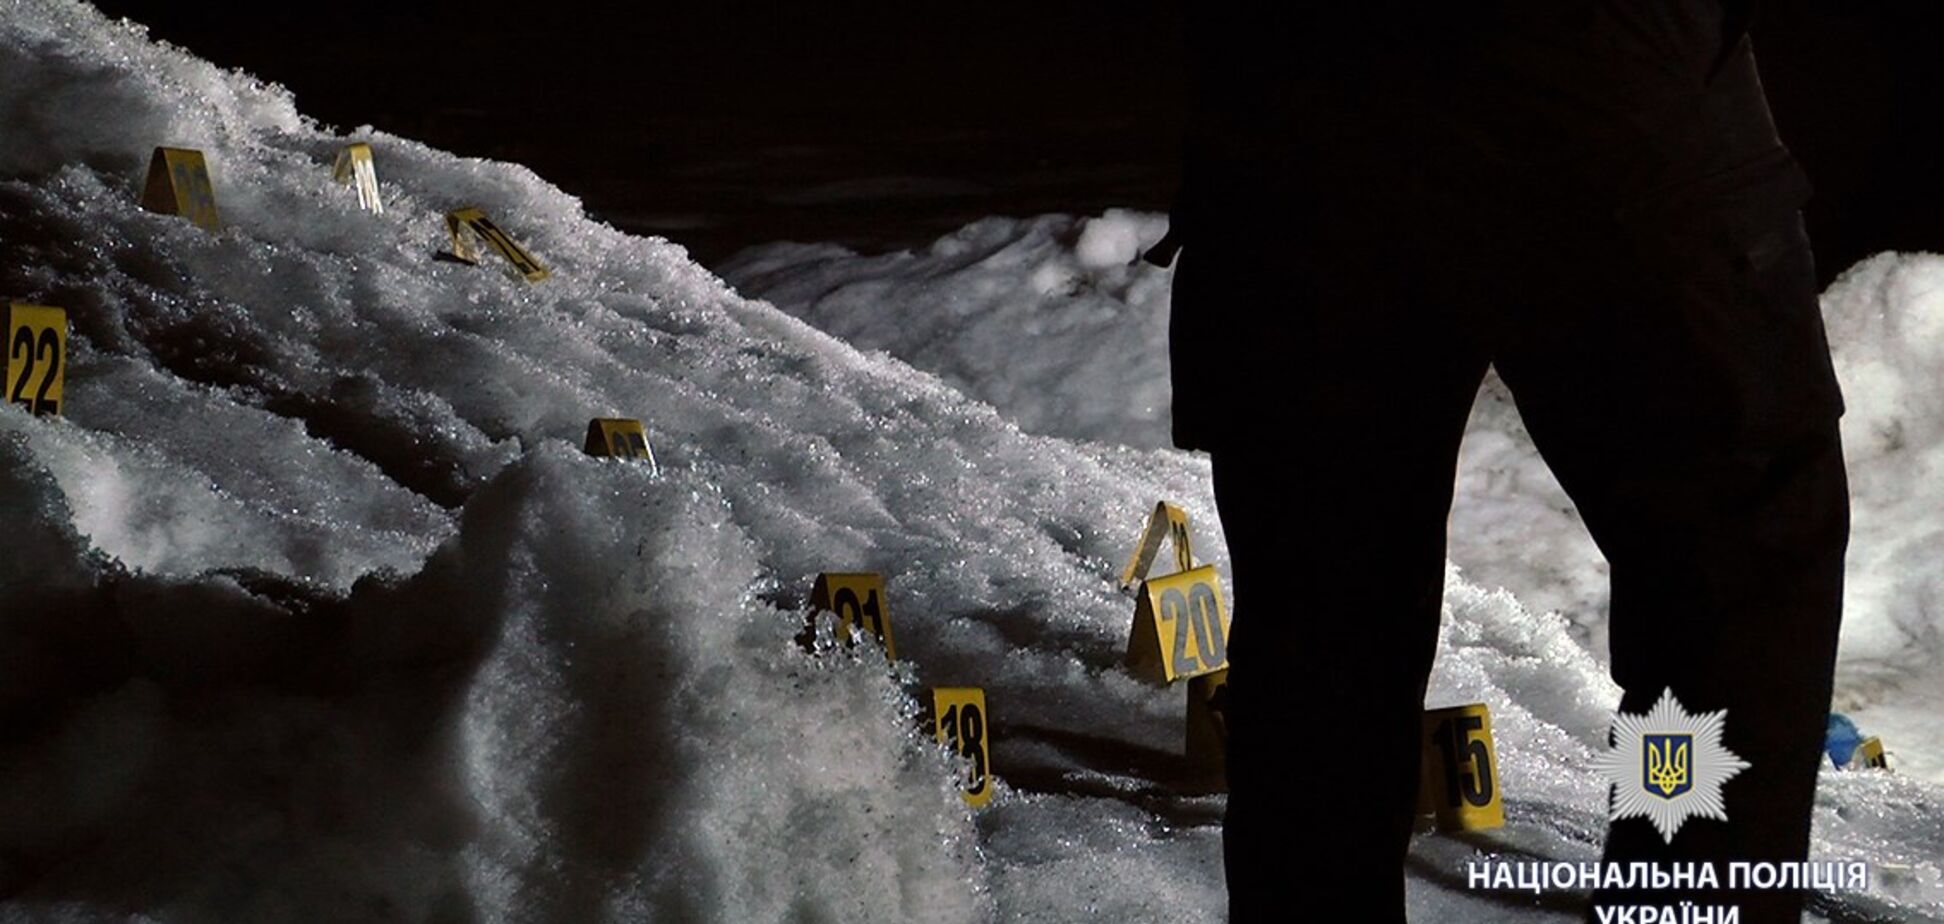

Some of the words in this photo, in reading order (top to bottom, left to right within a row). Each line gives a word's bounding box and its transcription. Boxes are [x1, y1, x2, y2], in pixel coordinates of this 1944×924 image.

[13, 325, 59, 416] 22
[1161, 582, 1226, 676] 20
[940, 704, 986, 795] 18
[1432, 716, 1493, 807] 15
